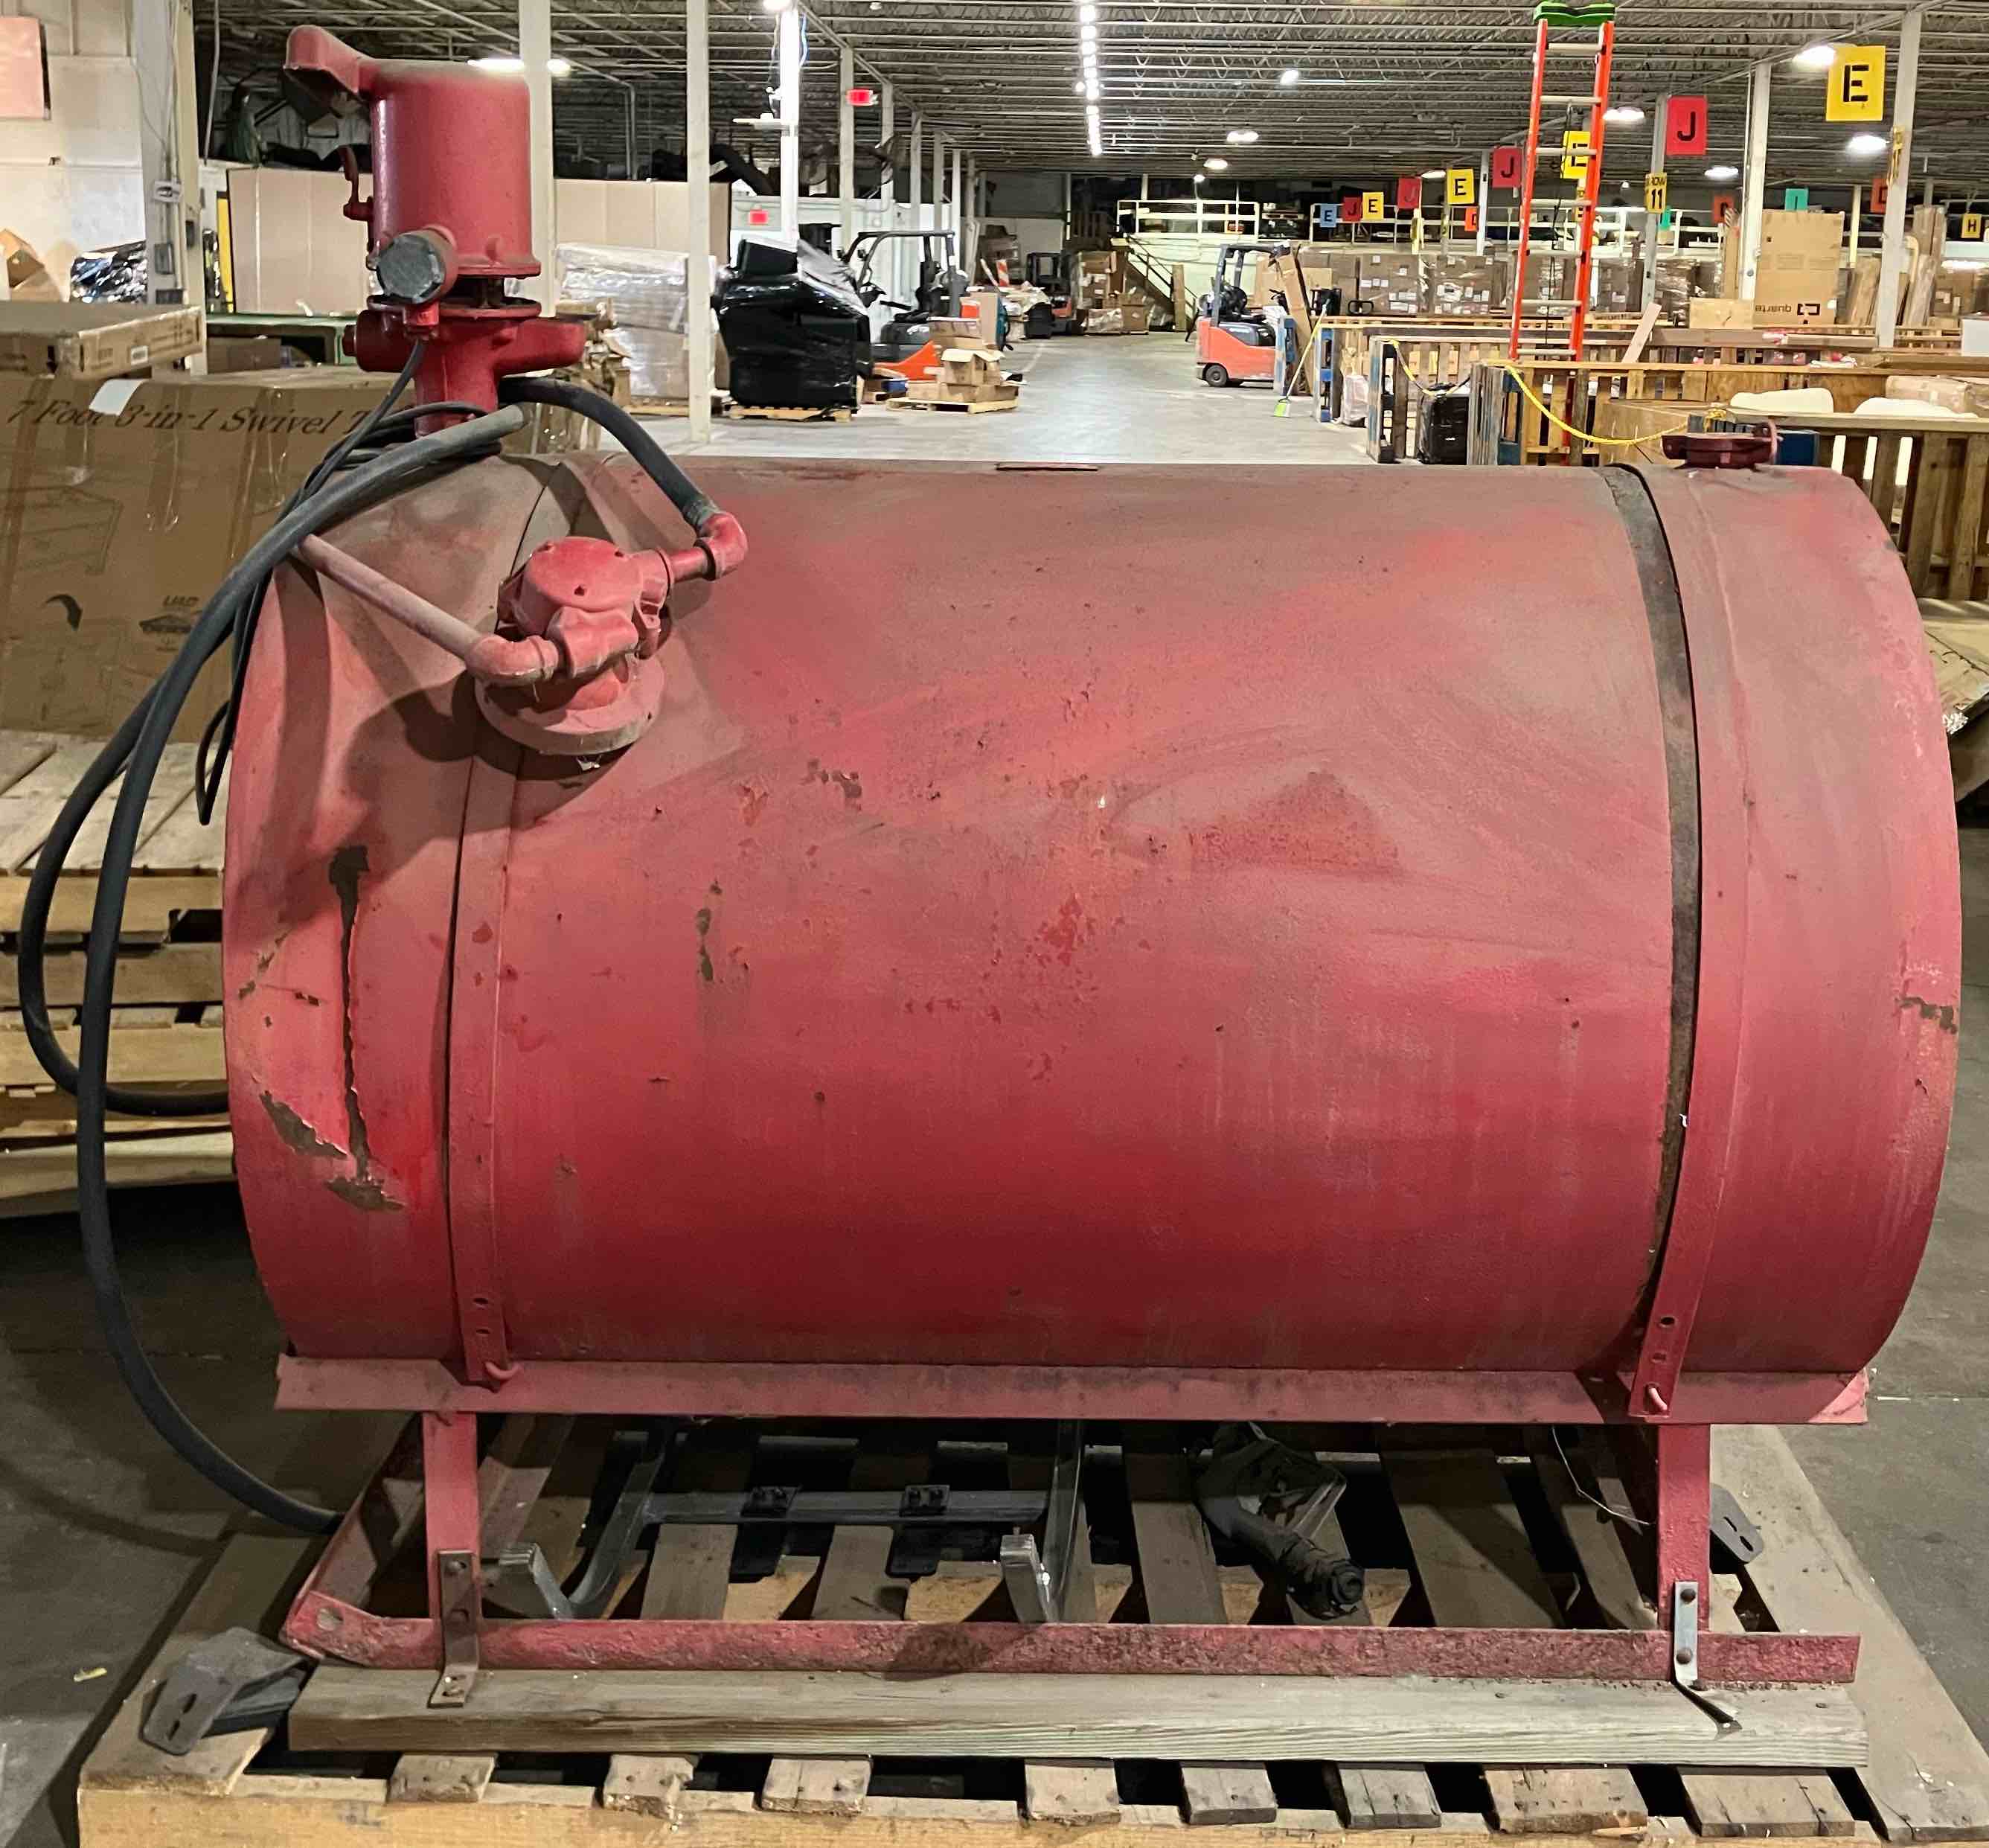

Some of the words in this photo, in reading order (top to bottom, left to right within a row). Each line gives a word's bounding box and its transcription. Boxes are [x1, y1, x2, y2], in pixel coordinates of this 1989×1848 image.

[1842, 64, 1869, 103] E
[1677, 111, 1696, 141] J
[1500, 157, 1514, 178] J
[1404, 186, 1416, 202] J
[1455, 178, 1467, 196] E
[1368, 199, 1378, 213] E
[1651, 188, 1663, 209] 11
[1325, 210, 1333, 223] E
[1348, 202, 1357, 216] J
[1968, 219, 1976, 232] H
[7, 400, 36, 423] 7
[114, 404, 220, 430] 3-in-1
[220, 407, 344, 435] Swivel
